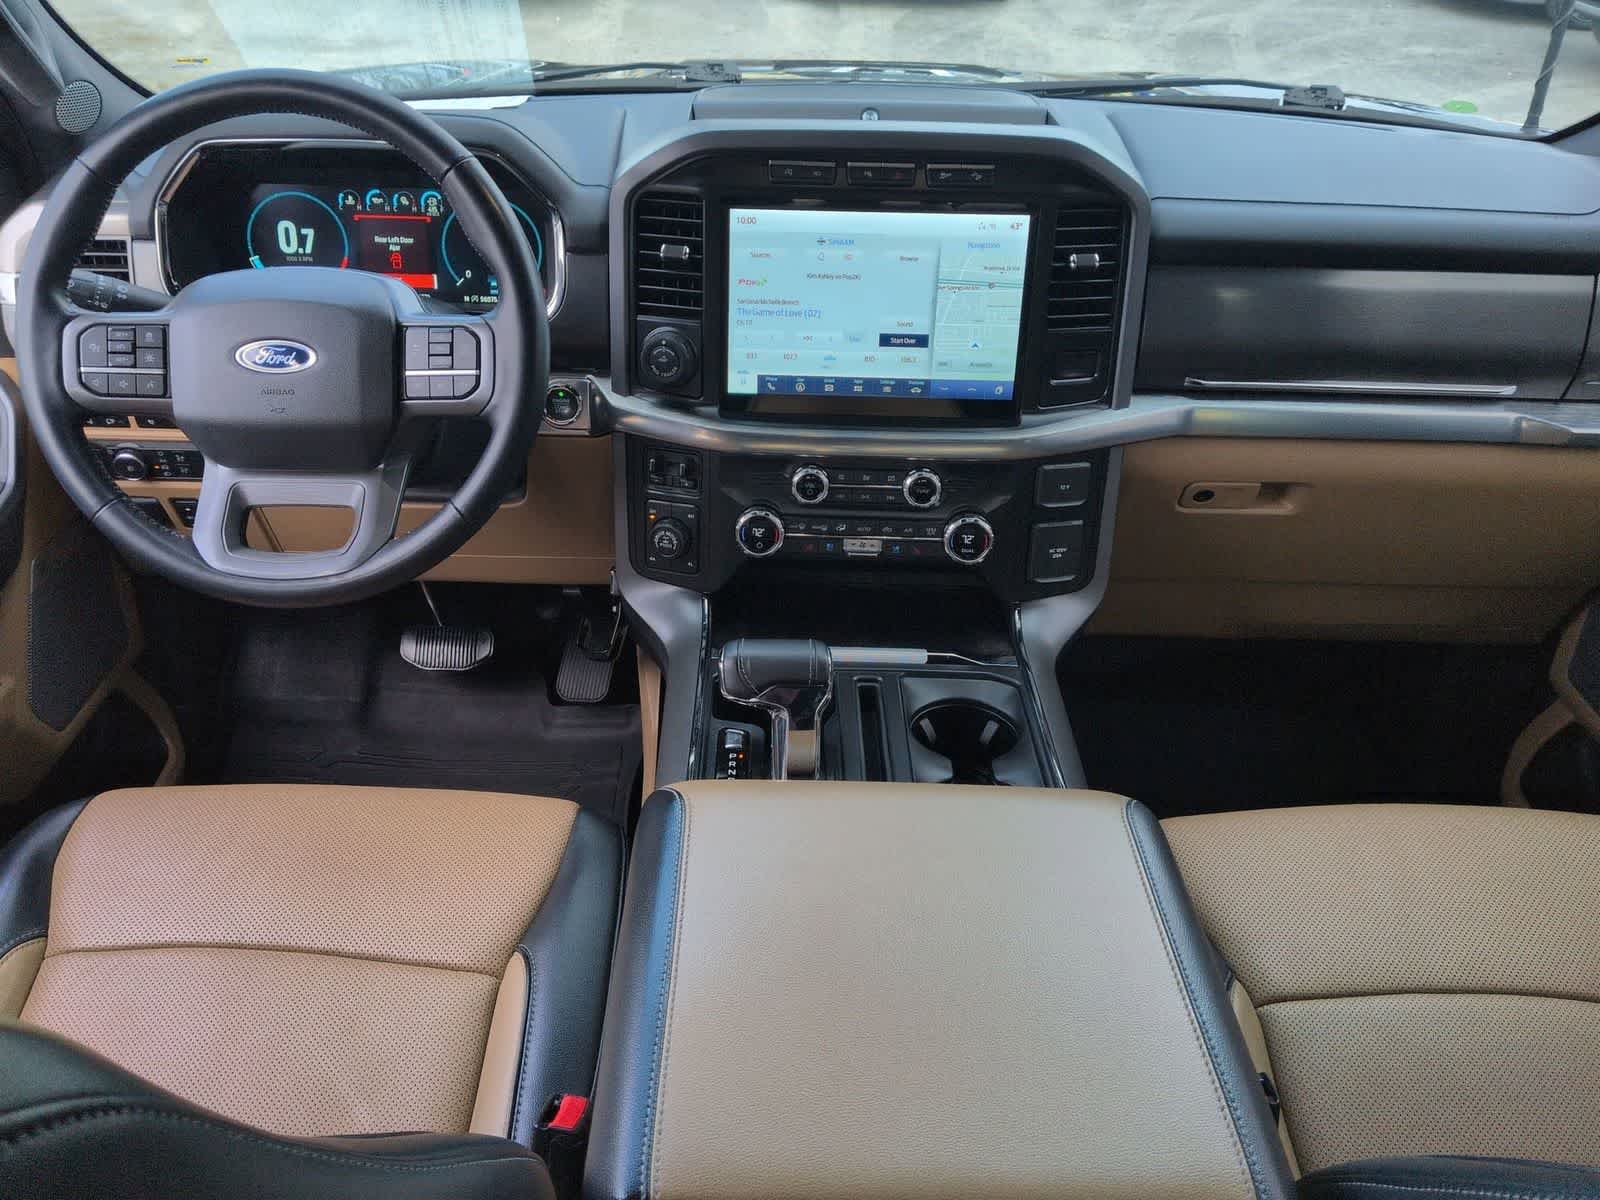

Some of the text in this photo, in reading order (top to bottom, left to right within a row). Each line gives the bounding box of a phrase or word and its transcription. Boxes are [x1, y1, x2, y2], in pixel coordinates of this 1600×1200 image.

[736, 216, 757, 225] 10:00
[277, 219, 315, 254] 0.7
[400, 236, 414, 244] Door
[465, 269, 472, 278] 0
[737, 307, 752, 316] The
[255, 345, 297, 365] Ford
[260, 388, 296, 396] AIRBAG
